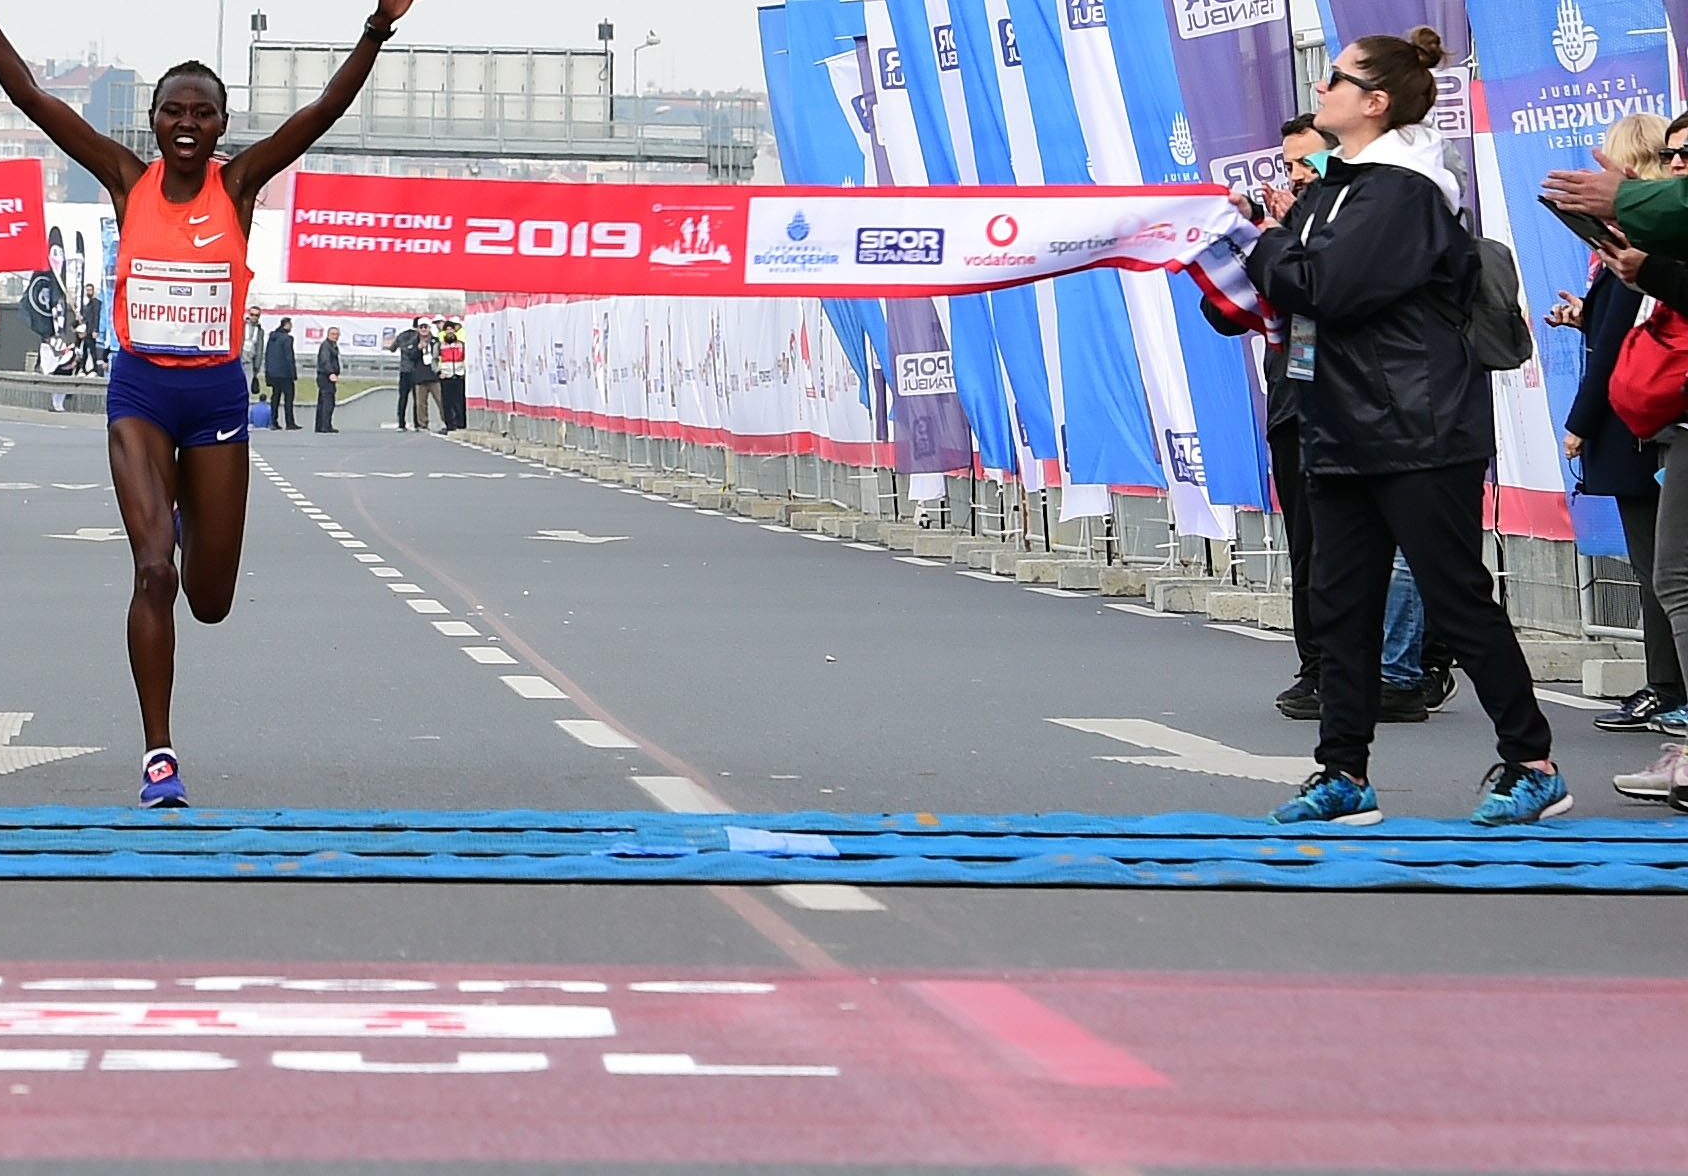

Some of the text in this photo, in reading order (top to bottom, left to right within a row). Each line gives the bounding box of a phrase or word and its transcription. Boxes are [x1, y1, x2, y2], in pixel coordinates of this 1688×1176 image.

[295, 208, 453, 230] MARATONU
[297, 233, 452, 254] MARATHON
[464, 218, 642, 258] 2019
[859, 230, 940, 250] SPOR
[1049, 234, 1118, 255] sportive
[964, 252, 1036, 267] vodafone
[131, 303, 227, 323] CHEPNGETICH
[201, 329, 224, 347] 101
